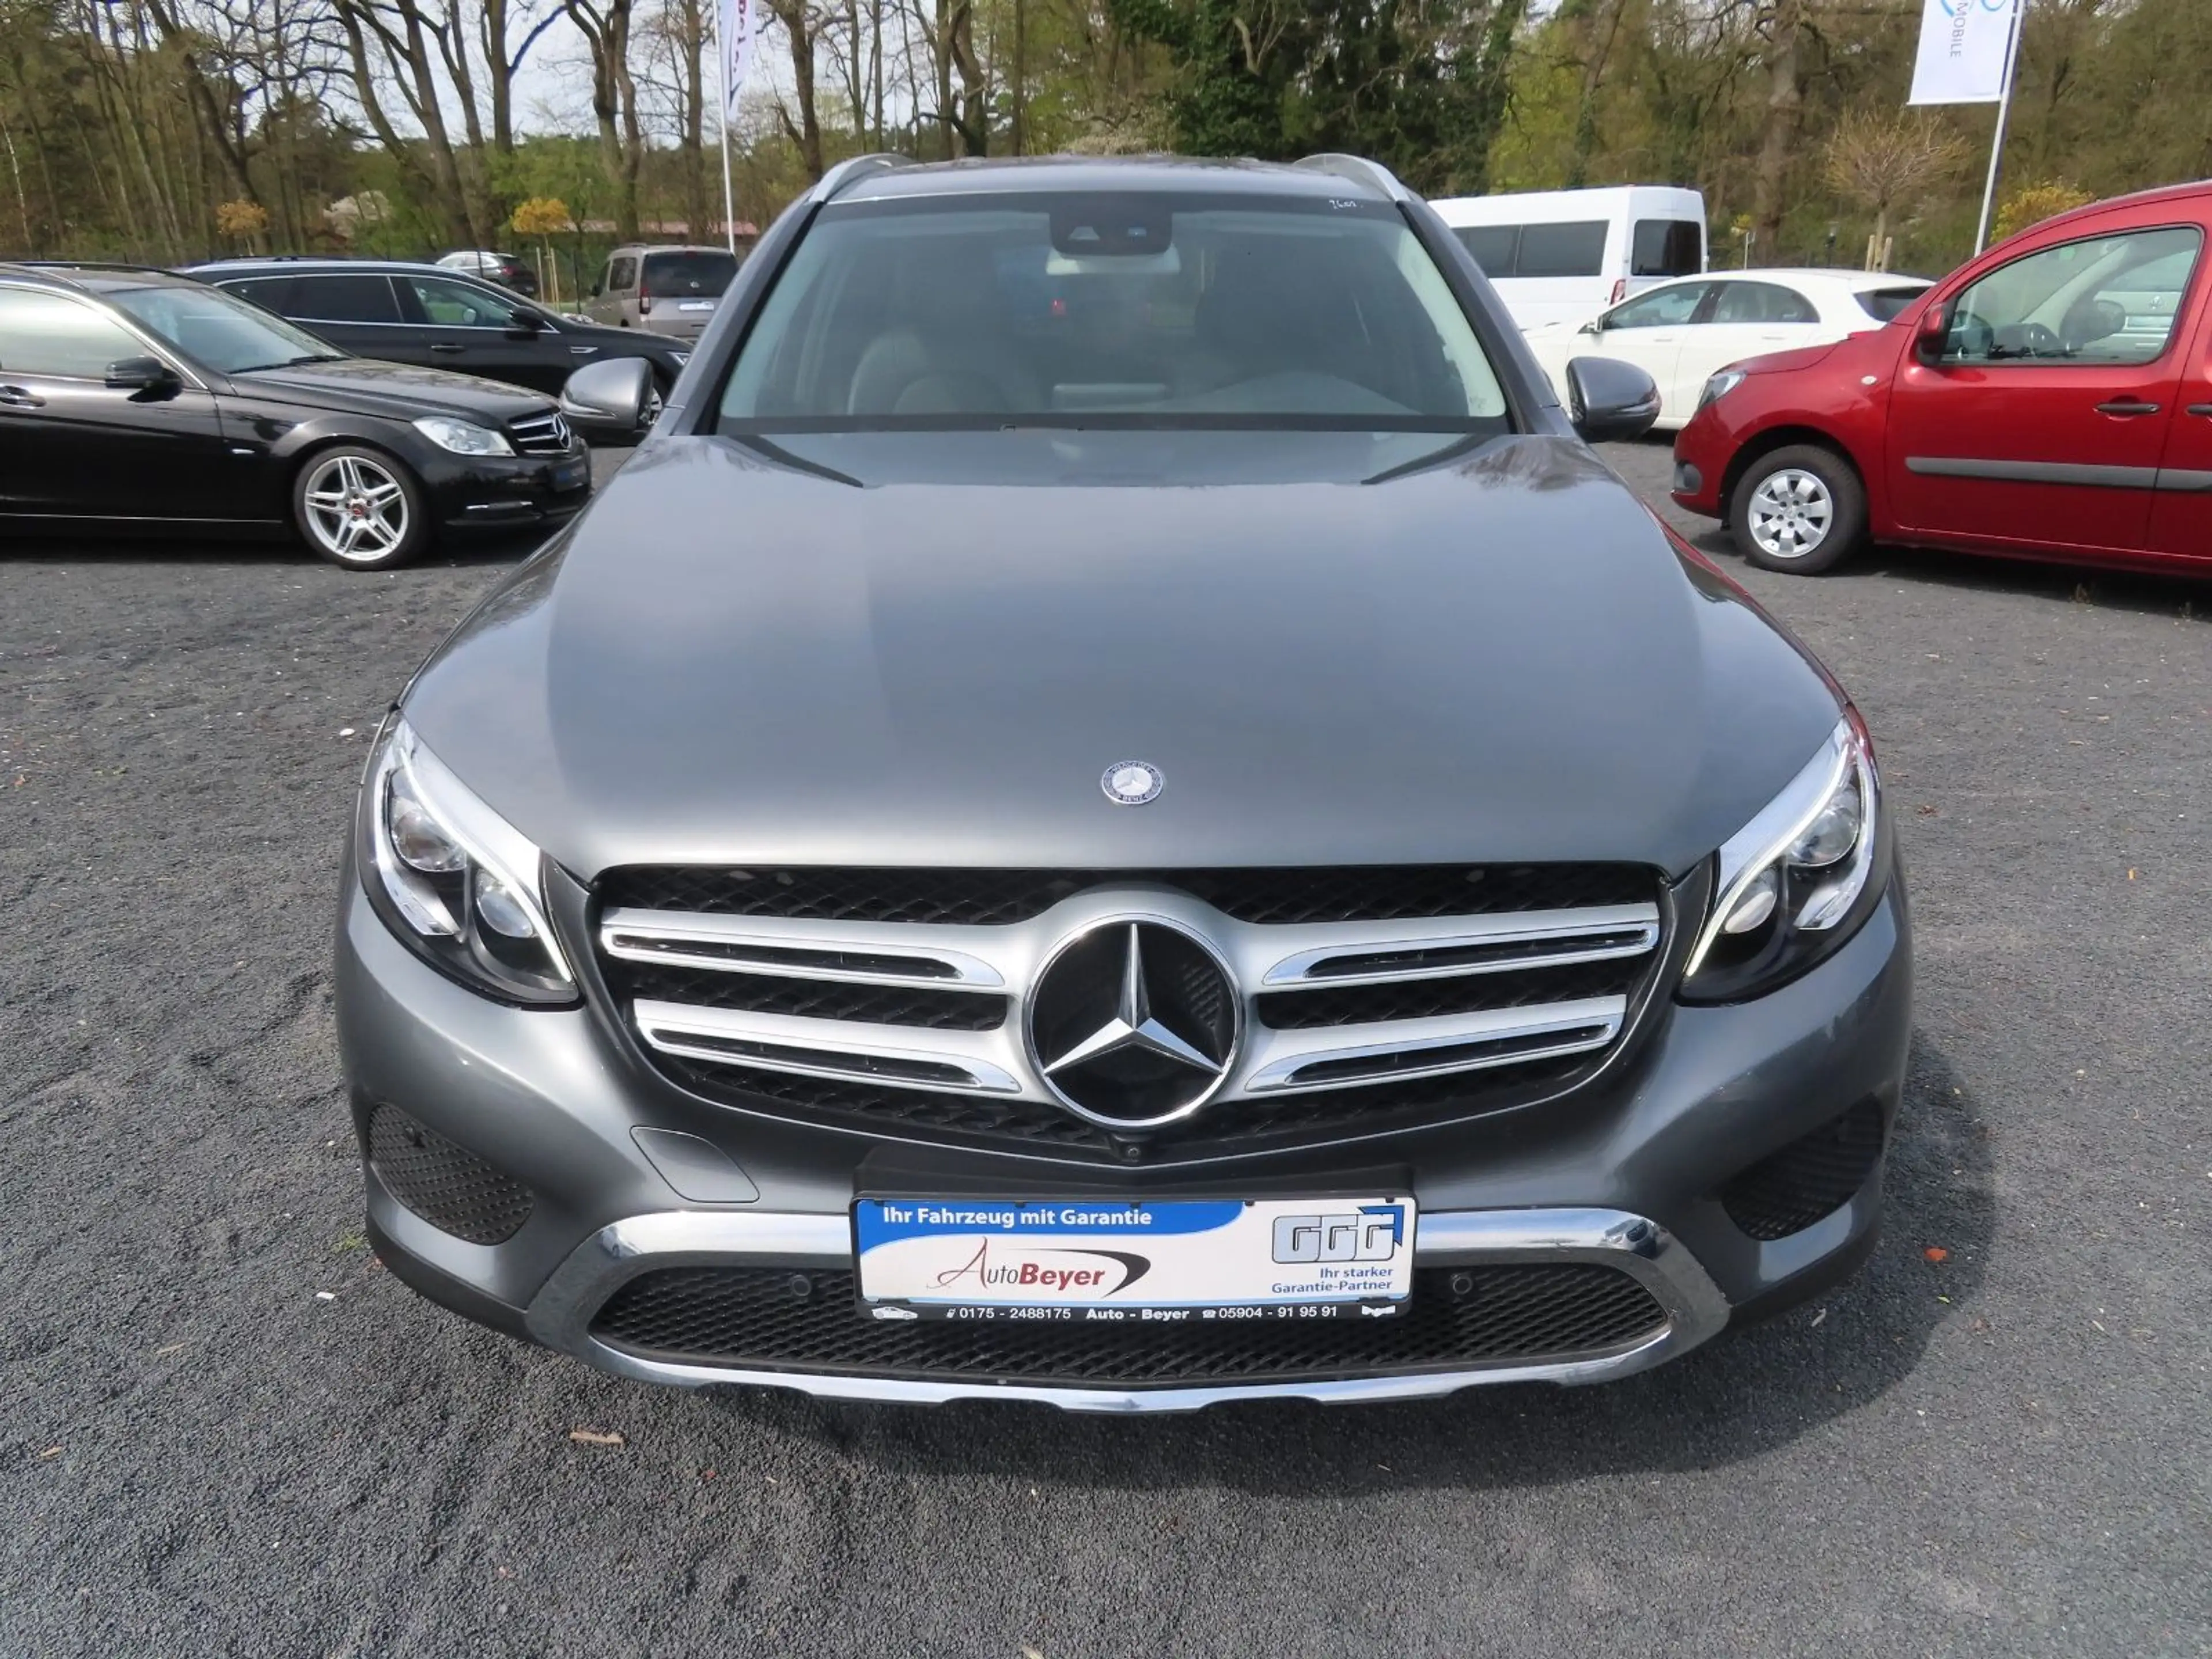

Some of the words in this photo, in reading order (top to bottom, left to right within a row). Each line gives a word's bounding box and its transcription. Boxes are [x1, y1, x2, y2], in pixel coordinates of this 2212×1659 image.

[884, 1207, 912, 1224] Ihr
[918, 1207, 1014, 1228] Fahrzeug
[1021, 1209, 1055, 1224] mit
[1060, 1210, 1152, 1225] Garantie
[1320, 1268, 1340, 1278] Ihr
[1343, 1267, 1393, 1278] starker
[1271, 1281, 1392, 1294] Garantie-Partner
[960, 1308, 995, 1319] 0175
[1010, 1308, 1071, 1319] 2488175
[1085, 1309, 1124, 1320] Auto
[1142, 1309, 1190, 1321] Beyer
[1219, 1306, 1263, 1318] 05904
[1277, 1306, 1294, 1317] 91
[1299, 1306, 1317, 1317] 95
[1321, 1305, 1337, 1317] 91
